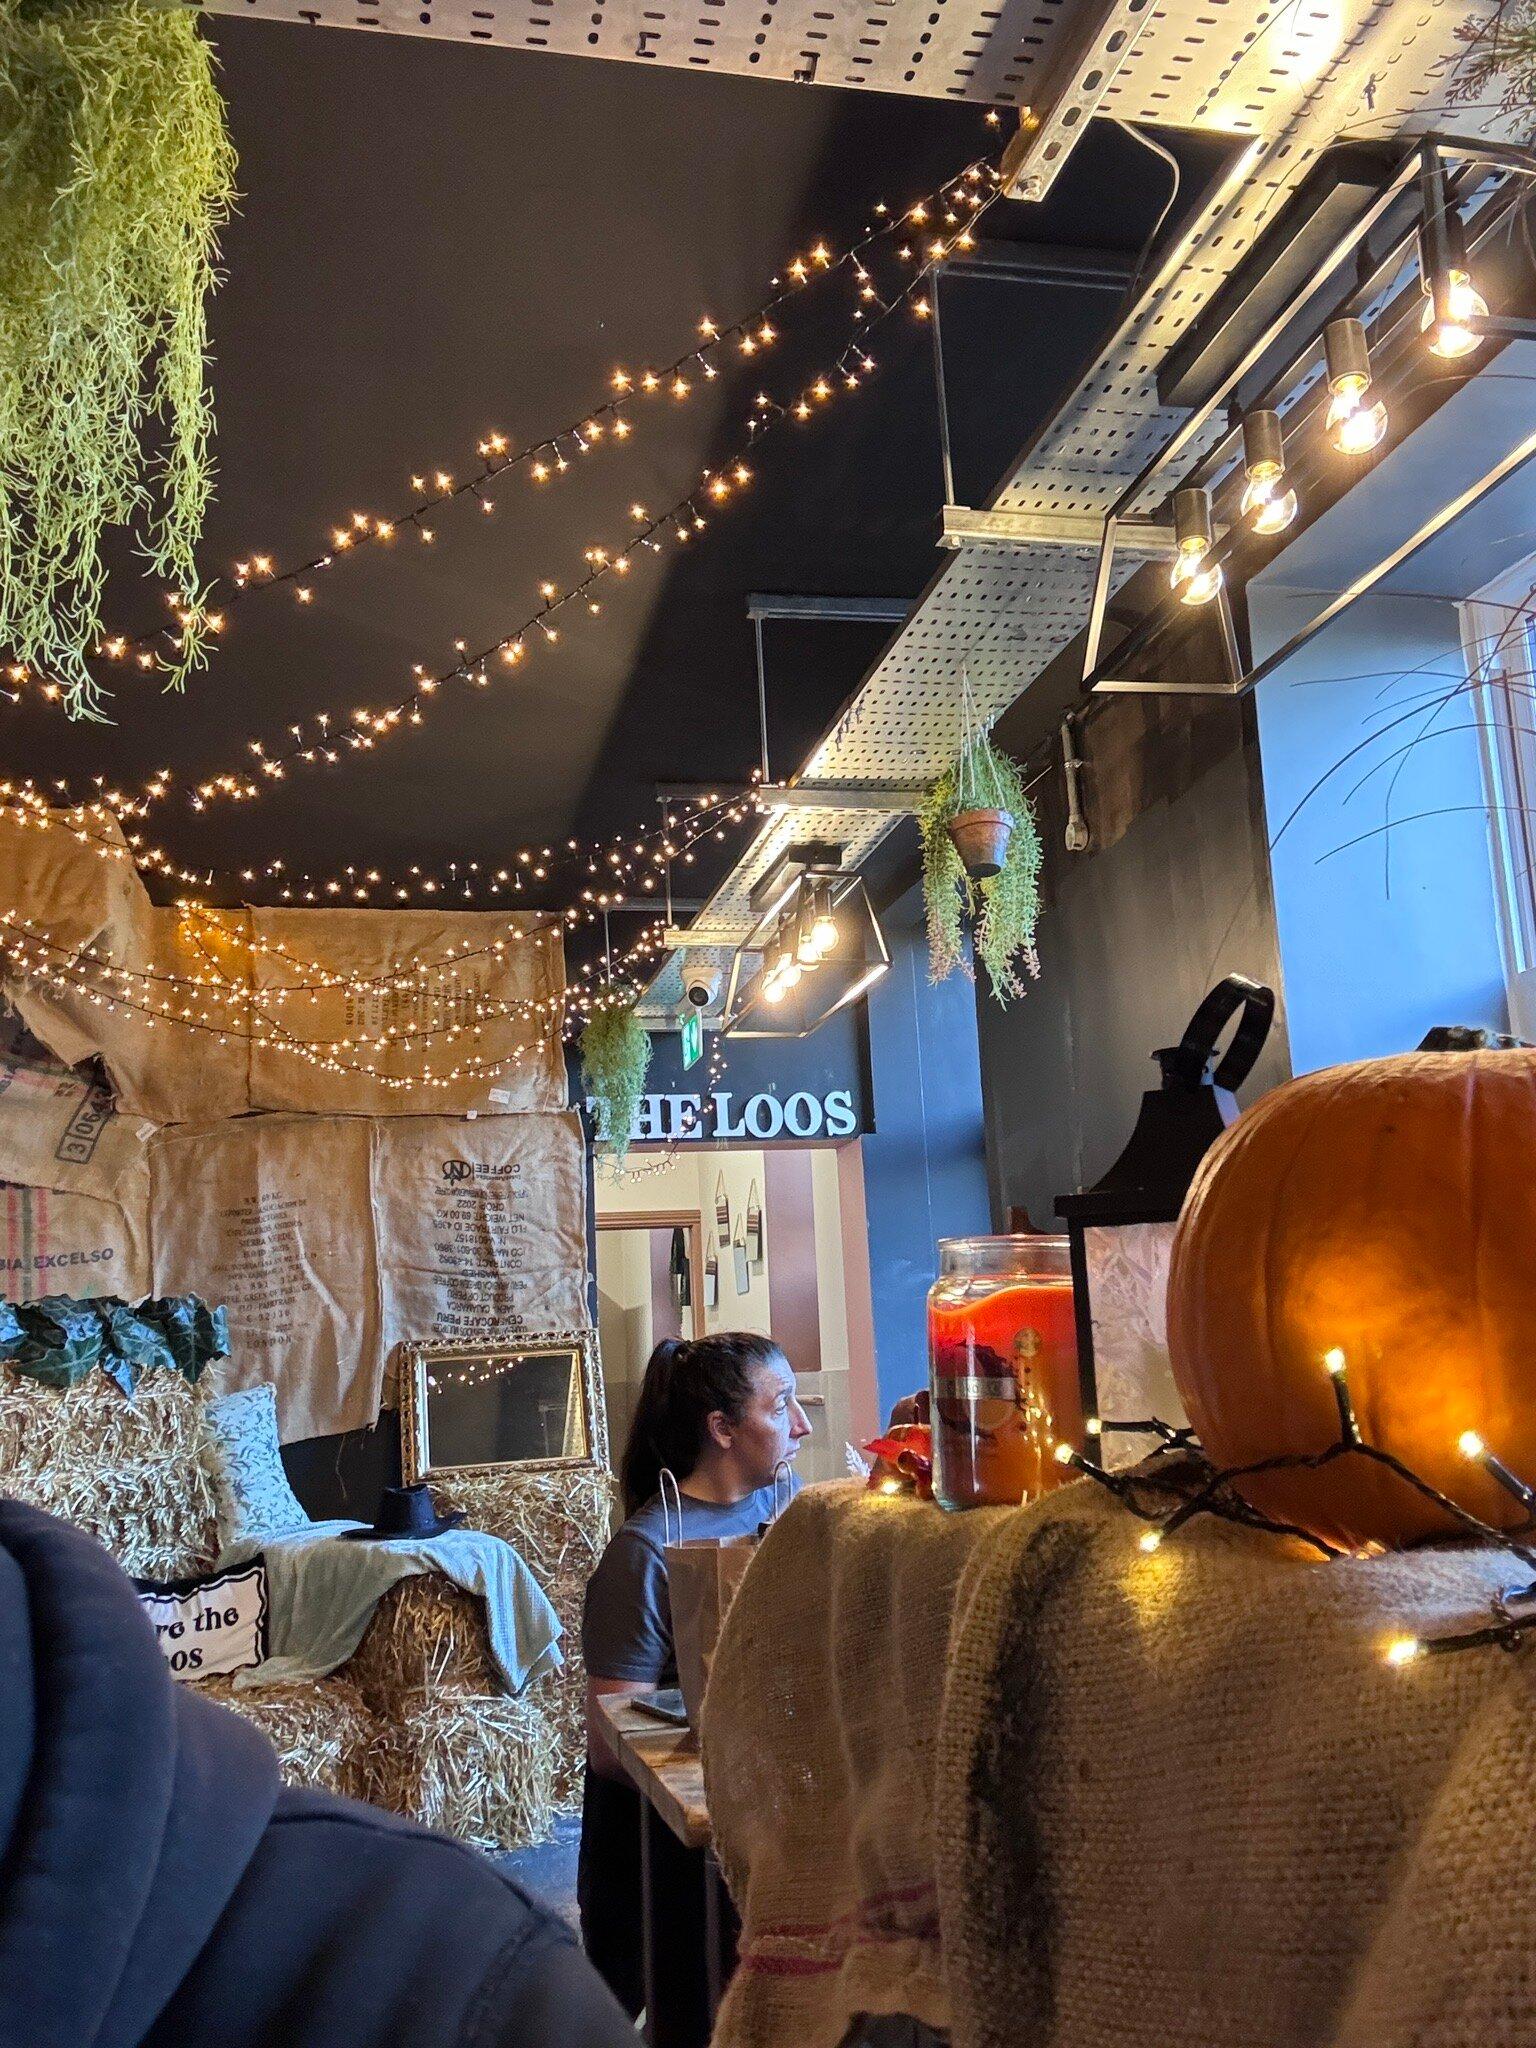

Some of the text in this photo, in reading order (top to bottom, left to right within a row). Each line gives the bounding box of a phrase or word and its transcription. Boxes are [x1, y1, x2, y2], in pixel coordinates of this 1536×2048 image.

[586, 1090, 857, 1141] THE LOOS
[475, 1164, 520, 1174] COFFEE
[457, 1200, 476, 1209] 2022
[509, 1214, 524, 1222] NET
[33, 1248, 114, 1269] EXCELSO
[437, 1313, 460, 1324] PERU
[193, 1606, 239, 1632] the
[165, 1648, 203, 1671] os
